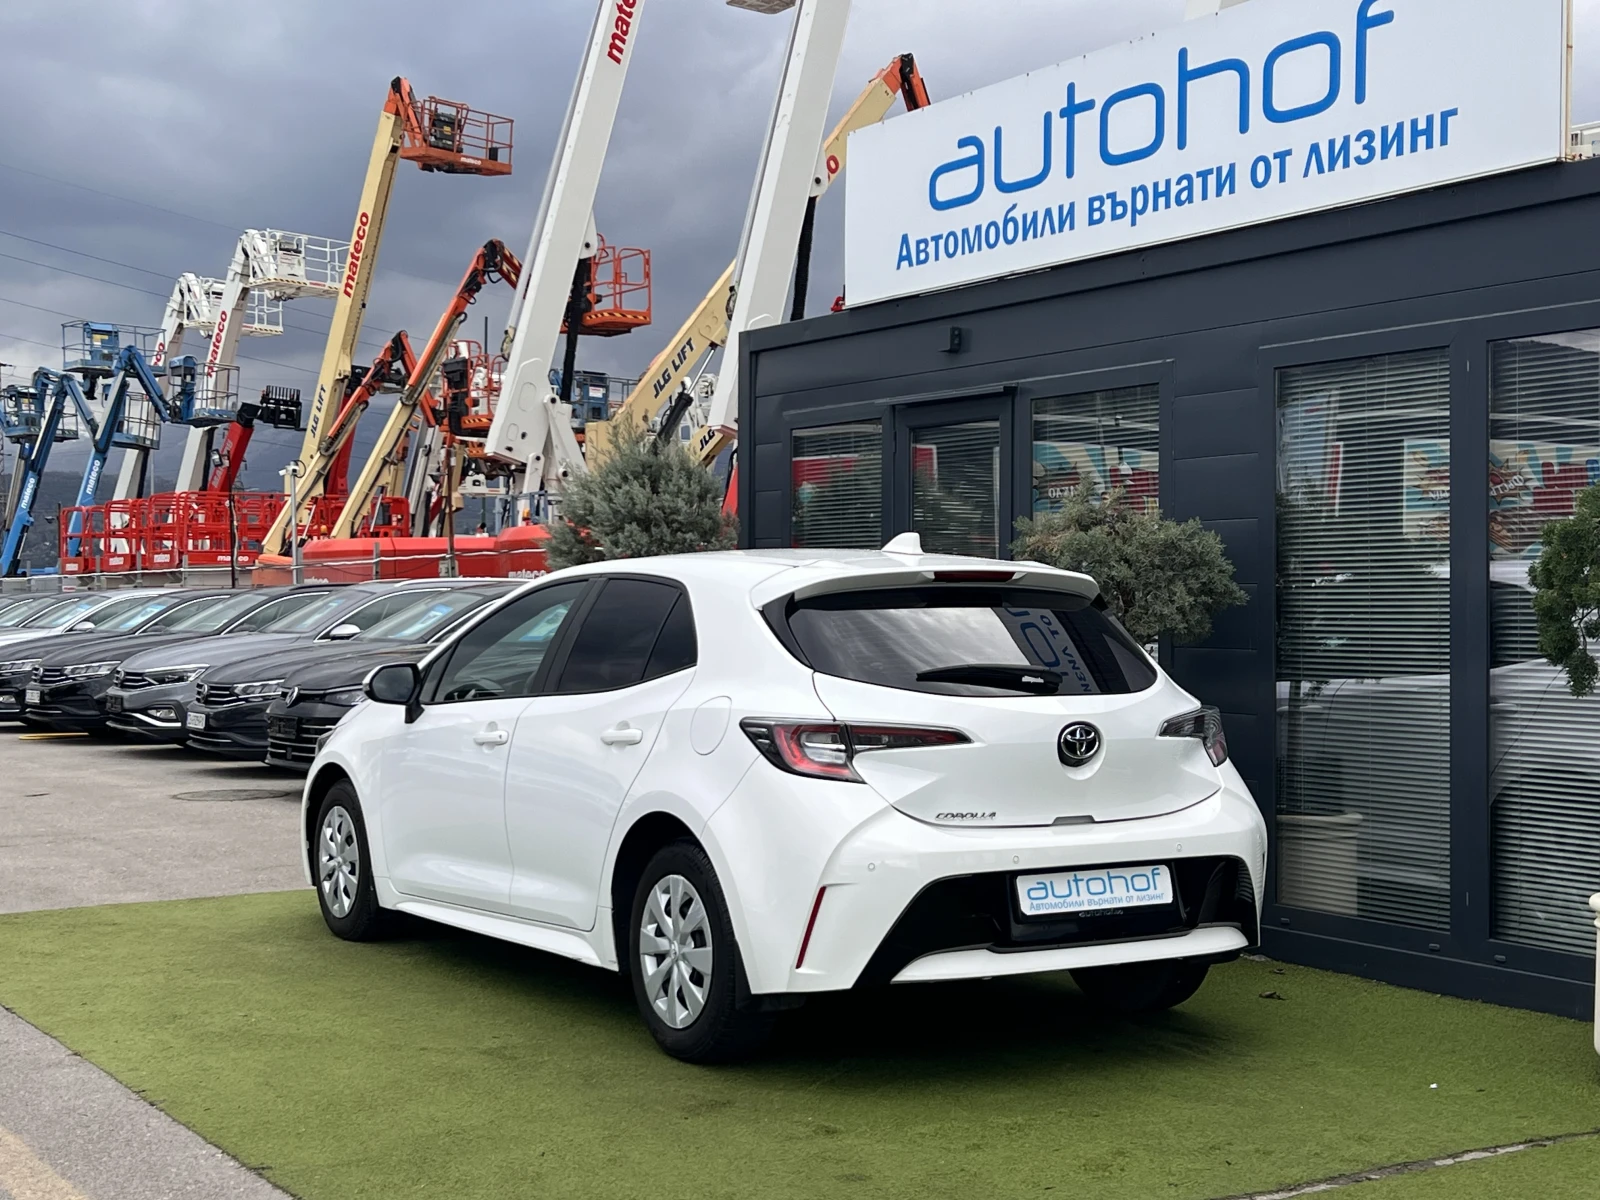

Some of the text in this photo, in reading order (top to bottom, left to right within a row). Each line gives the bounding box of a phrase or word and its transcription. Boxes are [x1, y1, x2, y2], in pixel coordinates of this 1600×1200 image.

[928, 0, 1395, 211] autohof
[896, 107, 1459, 271] Автомобили върнати от лизинг
[343, 212, 369, 298] mateco
[653, 337, 695, 399] JLG LIFT
[310, 414, 320, 438] JLG
[699, 428, 716, 452] JLG
[20, 477, 36, 509] mateco
[85, 459, 101, 495] mateco
[1026, 867, 1161, 901] autohof
[1029, 892, 1165, 912] Автомобили върнати от лизинг
